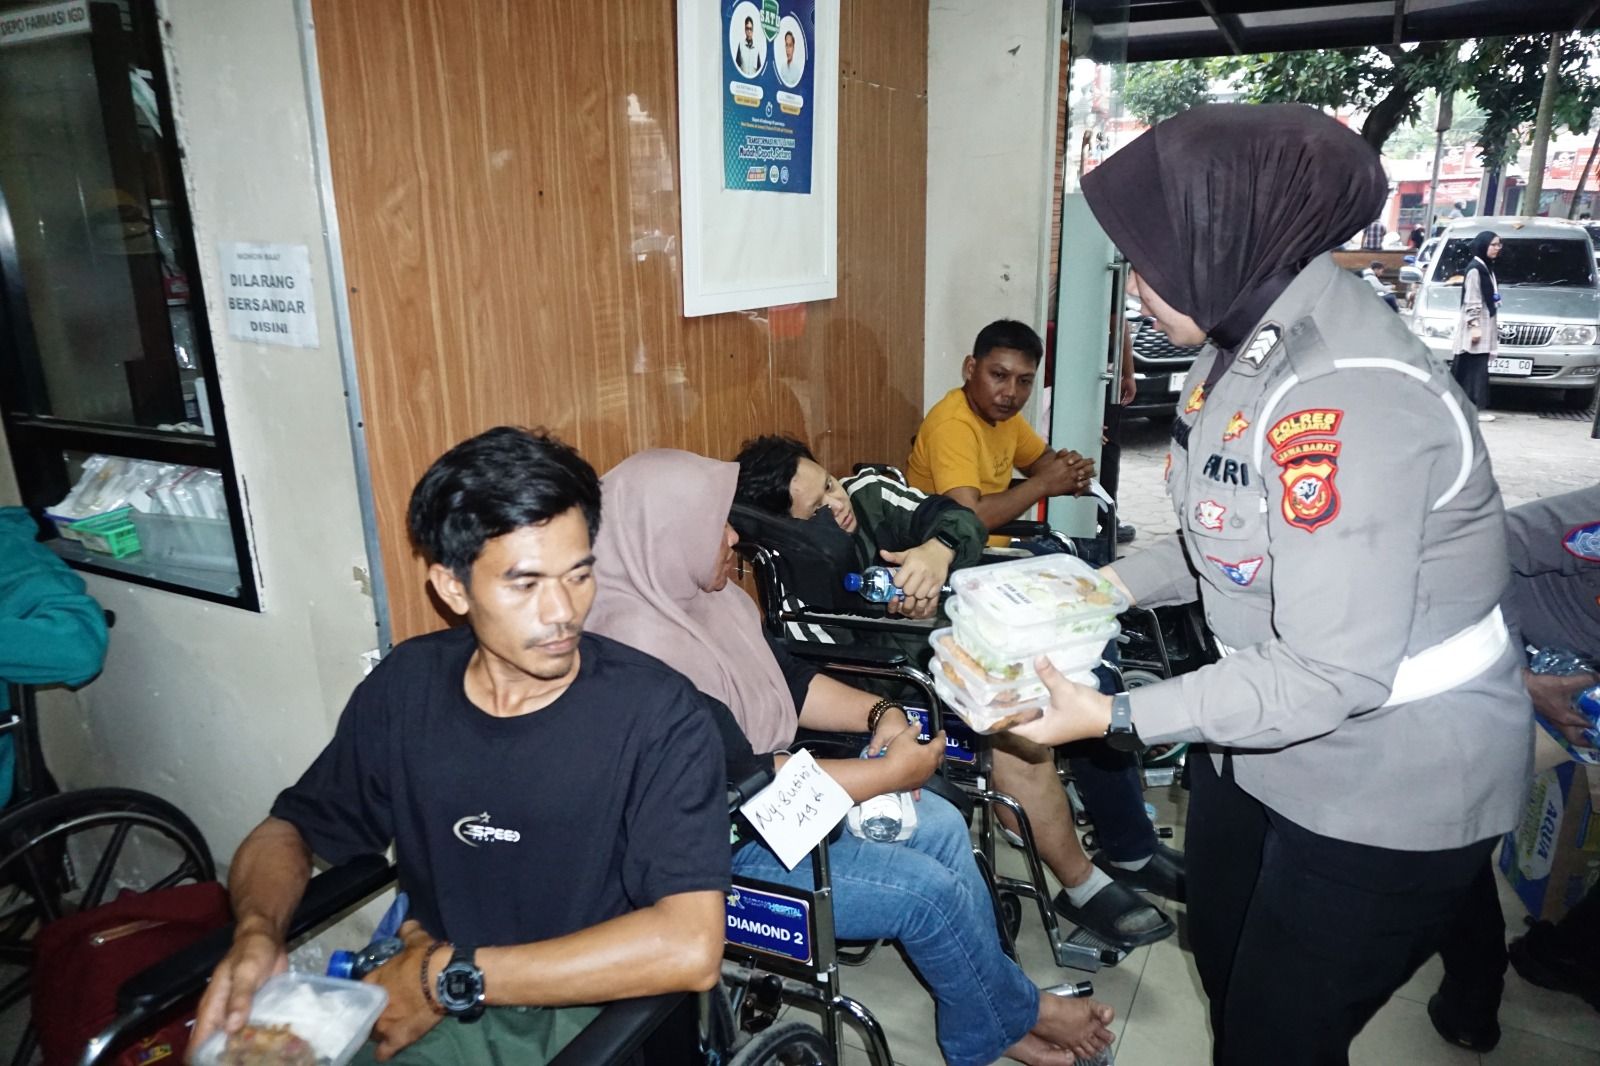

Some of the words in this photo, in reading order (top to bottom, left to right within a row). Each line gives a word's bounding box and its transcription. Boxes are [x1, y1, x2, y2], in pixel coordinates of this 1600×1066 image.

[230, 273, 295, 289] DILARANG
[228, 297, 305, 314] BERSANDAR
[250, 321, 288, 334] DISINI
[1272, 412, 1337, 438] POLRES
[1537, 800, 1560, 860] AQUA
[727, 914, 791, 941] DIAMOND
[793, 931, 804, 945] 2
